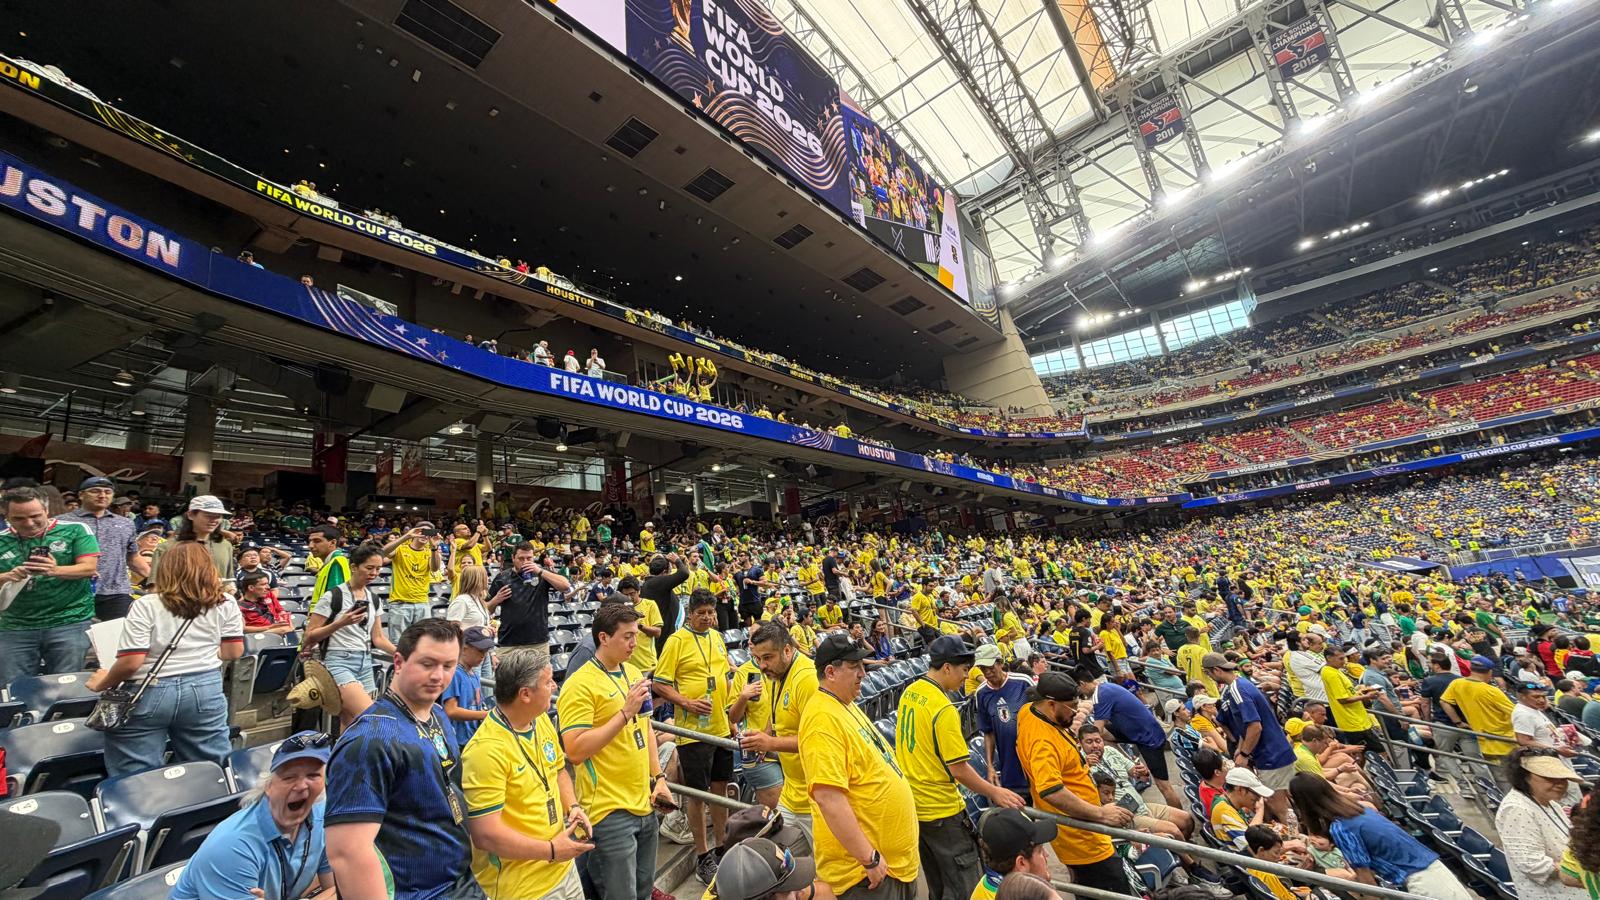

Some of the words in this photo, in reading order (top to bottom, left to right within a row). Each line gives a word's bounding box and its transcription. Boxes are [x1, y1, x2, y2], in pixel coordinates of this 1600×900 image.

[703, 0, 753, 55] FIFA
[1272, 21, 1318, 50] CHAMPIONS
[1289, 20, 1311, 34] SOUTH
[703, 18, 784, 102] WORLD
[1292, 53, 1319, 73] 2012
[705, 49, 753, 96] CUP
[756, 90, 824, 156] 2026
[1137, 99, 1175, 121] CHAMPIONS
[1155, 127, 1175, 142] 2011
[256, 180, 293, 205] FIFA
[295, 197, 353, 226] WORLD
[356, 220, 386, 237] CUP
[388, 231, 437, 255] 2026
[546, 285, 595, 307] HOUSTON
[550, 372, 595, 397] FIFA
[597, 383, 661, 411] WORLD
[663, 399, 693, 418] CUP
[696, 407, 744, 429] 2026
[1426, 423, 1479, 438] HOUSTON
[858, 444, 896, 462] HOUSTON
[1461, 451, 1480, 460] FIFA
[1480, 446, 1507, 457] WORLD
[1507, 443, 1528, 452] CUP
[1529, 438, 1560, 449] 2026
[1071, 640, 1080, 660] 7
[900, 704, 916, 753] 10
